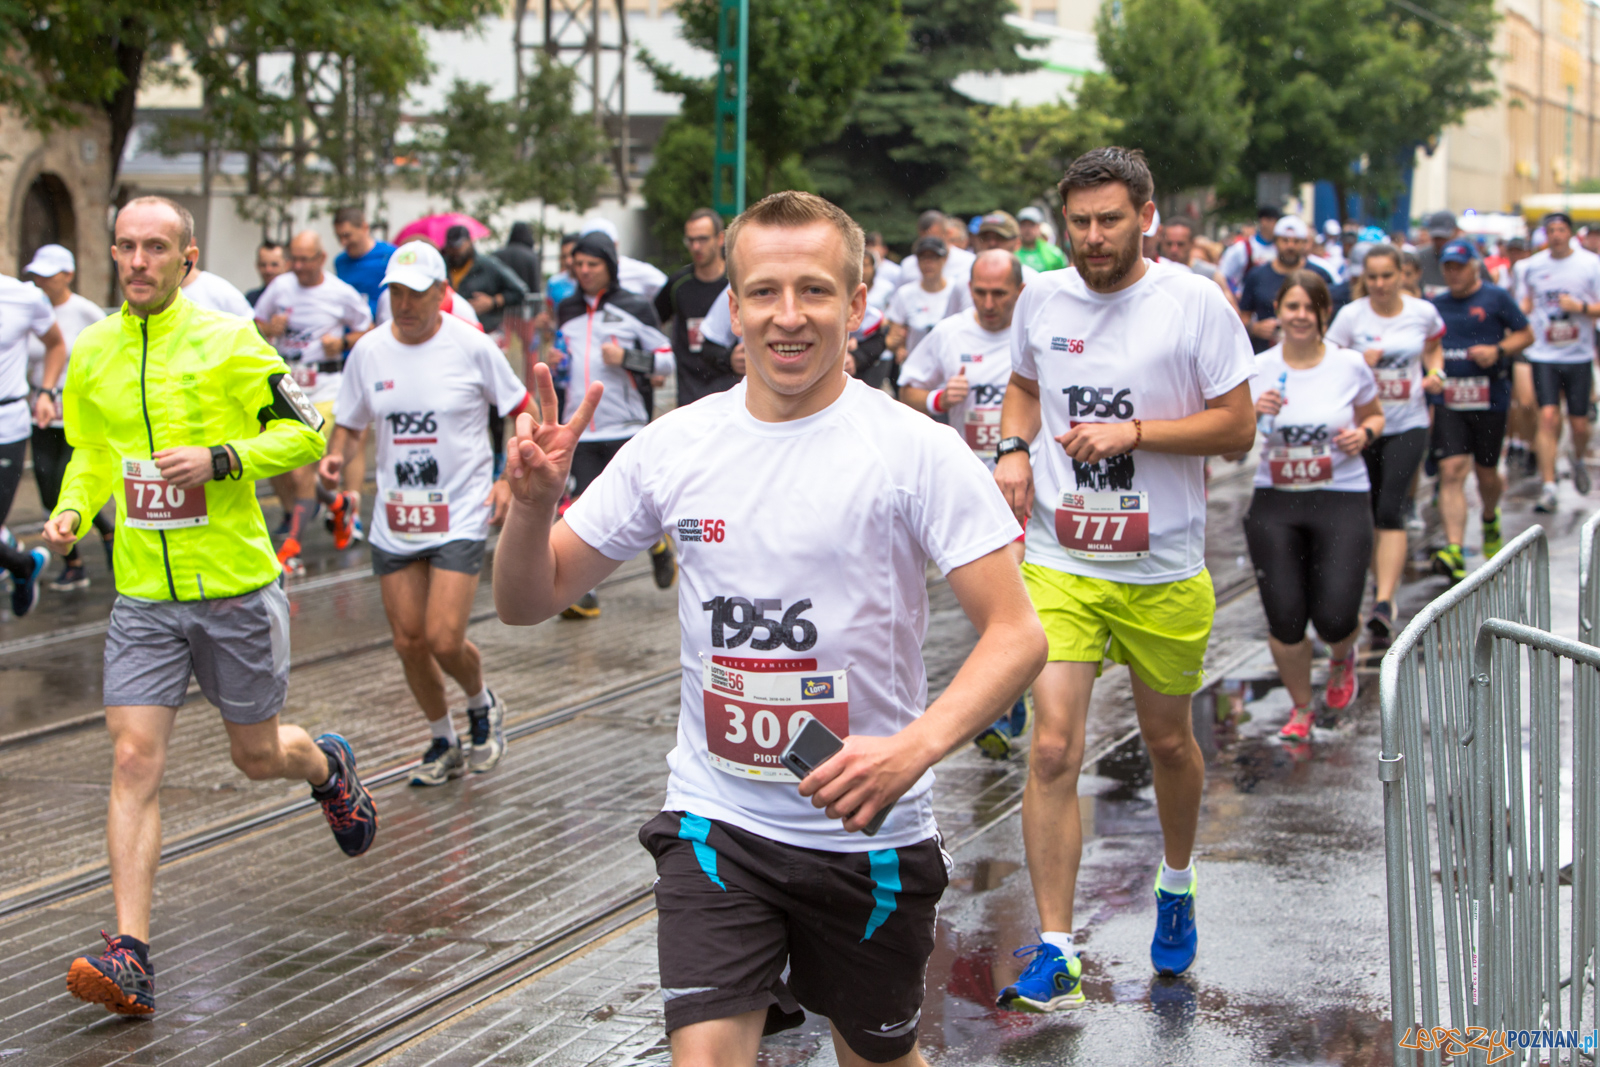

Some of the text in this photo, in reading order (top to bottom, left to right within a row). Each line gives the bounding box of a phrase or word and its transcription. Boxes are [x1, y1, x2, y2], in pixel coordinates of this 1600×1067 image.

[971, 384, 1007, 405] 195
[1062, 385, 1134, 419] 1956
[385, 411, 438, 434] 1956
[976, 426, 1001, 444] 55
[1277, 424, 1328, 443] 1956
[1281, 460, 1321, 478] 446
[133, 482, 185, 509] 720
[146, 511, 172, 519] TOMASZ
[395, 506, 436, 526] 343
[678, 519, 699, 528] LOTTO
[700, 519, 726, 543] '56
[1072, 514, 1128, 541] 777
[702, 596, 818, 652] 1956
[711, 666, 725, 677] LOTTO
[722, 660, 746, 668] BIEG
[809, 684, 826, 694] LOTTO
